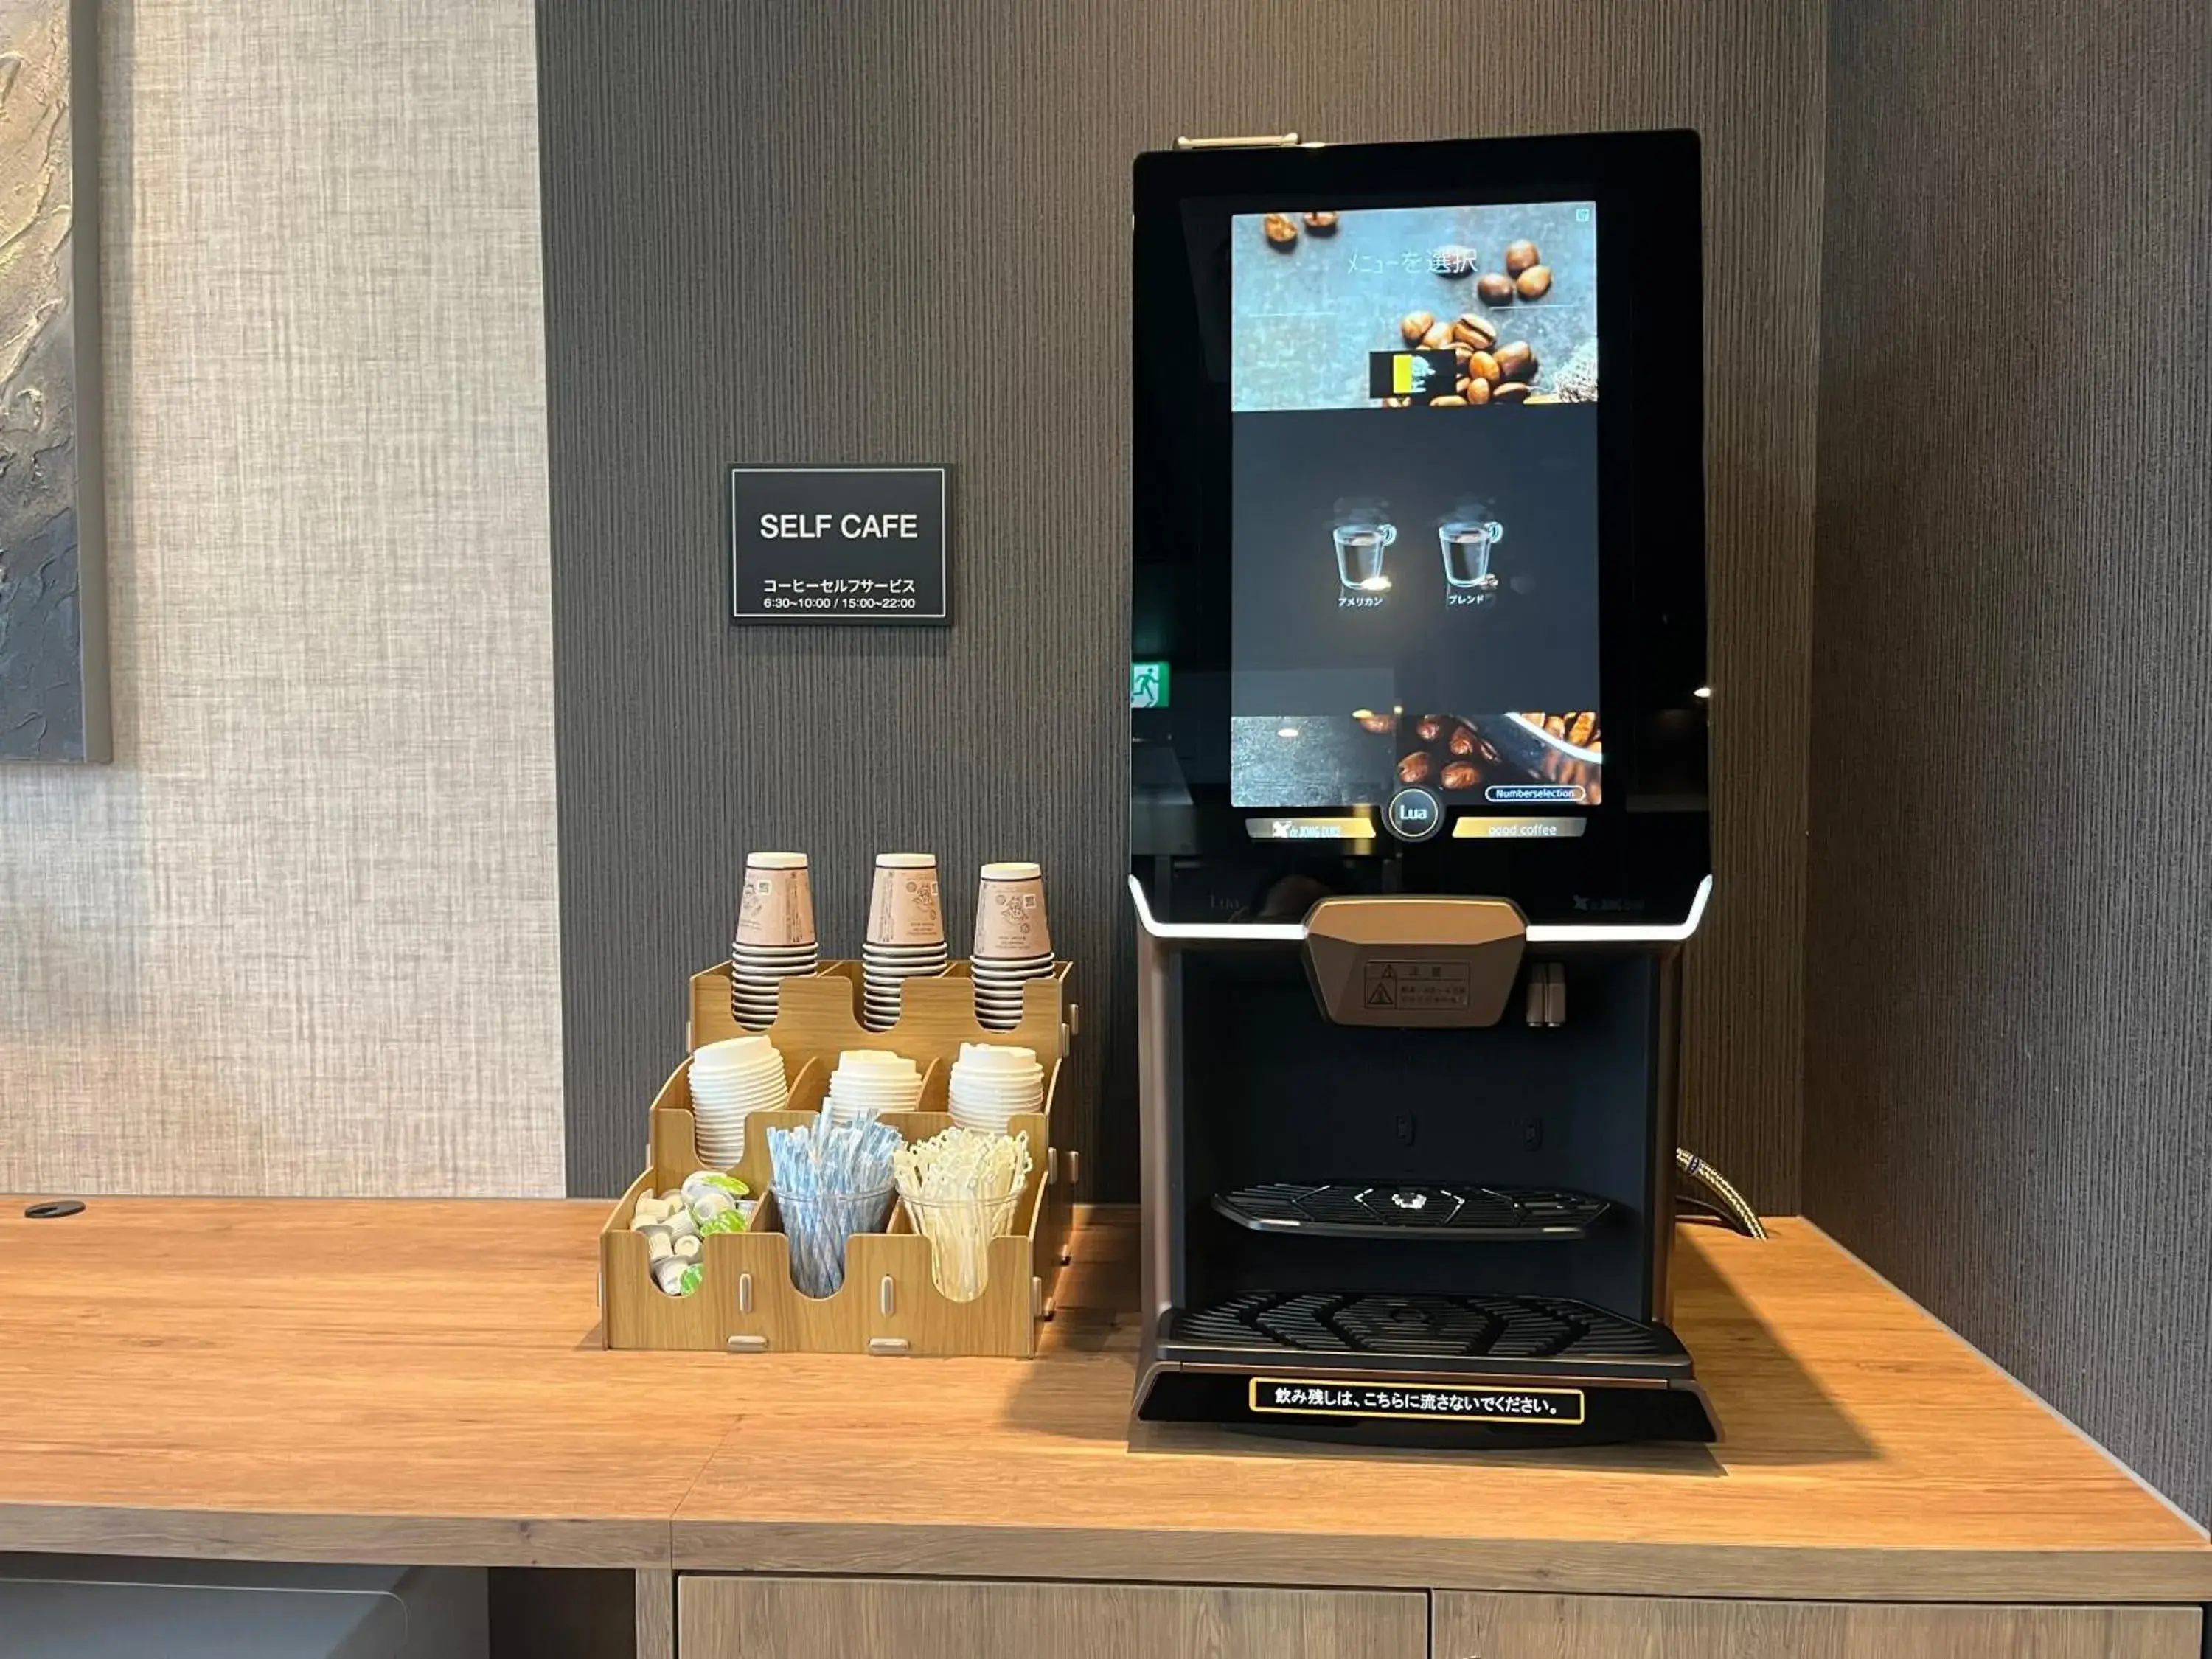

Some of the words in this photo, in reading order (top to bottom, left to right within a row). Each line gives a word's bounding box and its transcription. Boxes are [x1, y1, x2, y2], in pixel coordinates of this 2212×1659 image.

[1347, 248, 1478, 274] メニューを選択
[760, 514, 832, 538] SELF
[841, 514, 918, 538] CAFE
[764, 579, 915, 594] コーヒーセルフサービス
[1338, 597, 1383, 607] アメリカン
[1449, 594, 1484, 605] ブレンド
[1496, 788, 1575, 799] Numberselection
[1400, 804, 1428, 820] Lua
[1520, 824, 1558, 836] coffee
[1274, 1387, 1557, 1416] 飲み残しは、こちらに流さないでください。
